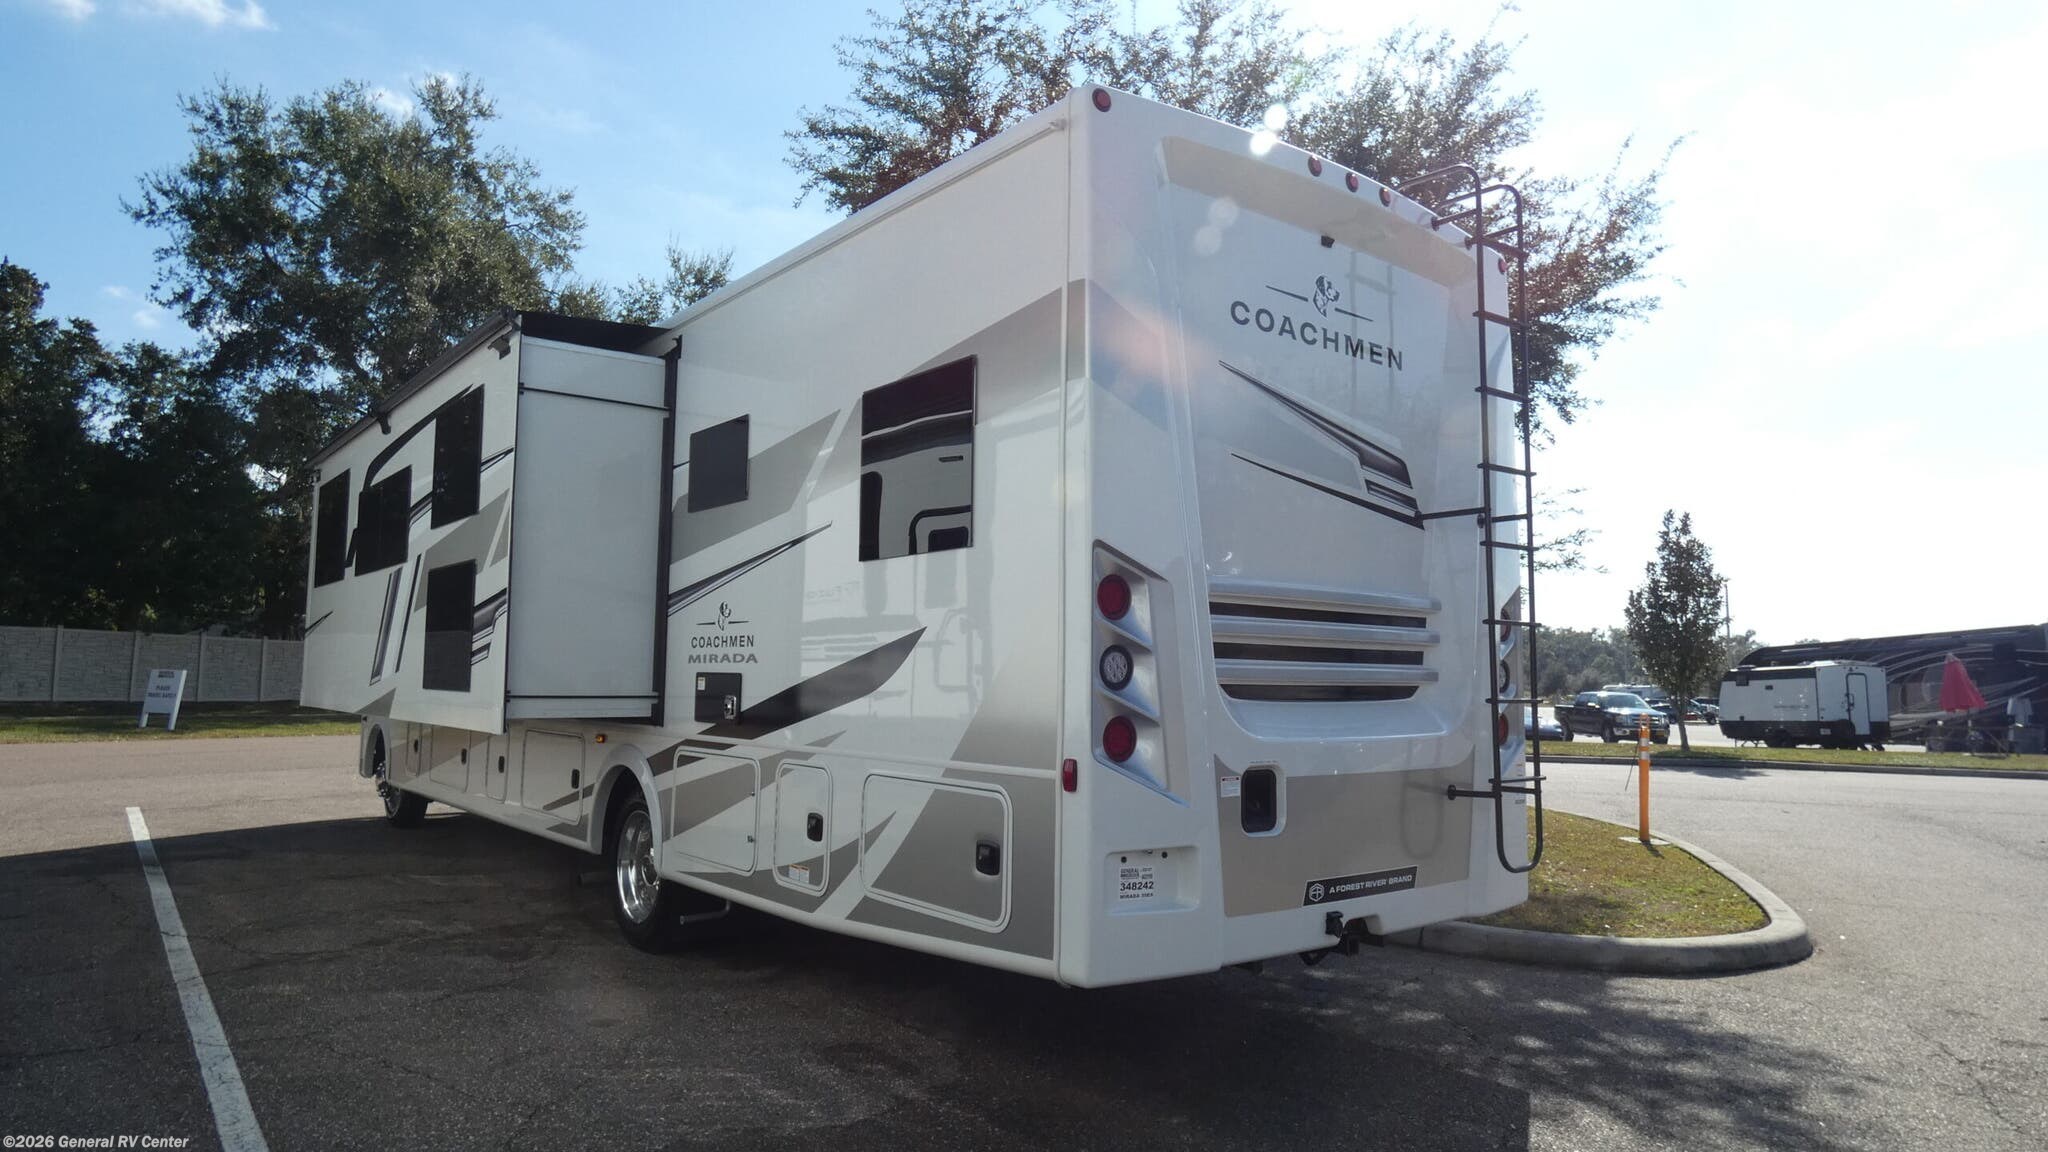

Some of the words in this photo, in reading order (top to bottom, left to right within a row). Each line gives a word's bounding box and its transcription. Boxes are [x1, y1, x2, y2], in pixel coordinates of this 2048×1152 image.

[1230, 300, 1403, 371] COACHMEN
[690, 635, 755, 649] COACHMEN
[687, 653, 758, 664] MIRADA
[1120, 881, 1154, 891] 348242
[1336, 882, 1365, 893] FOREST
[1365, 879, 1387, 889] RIVER
[1388, 875, 1412, 885] BRAND
